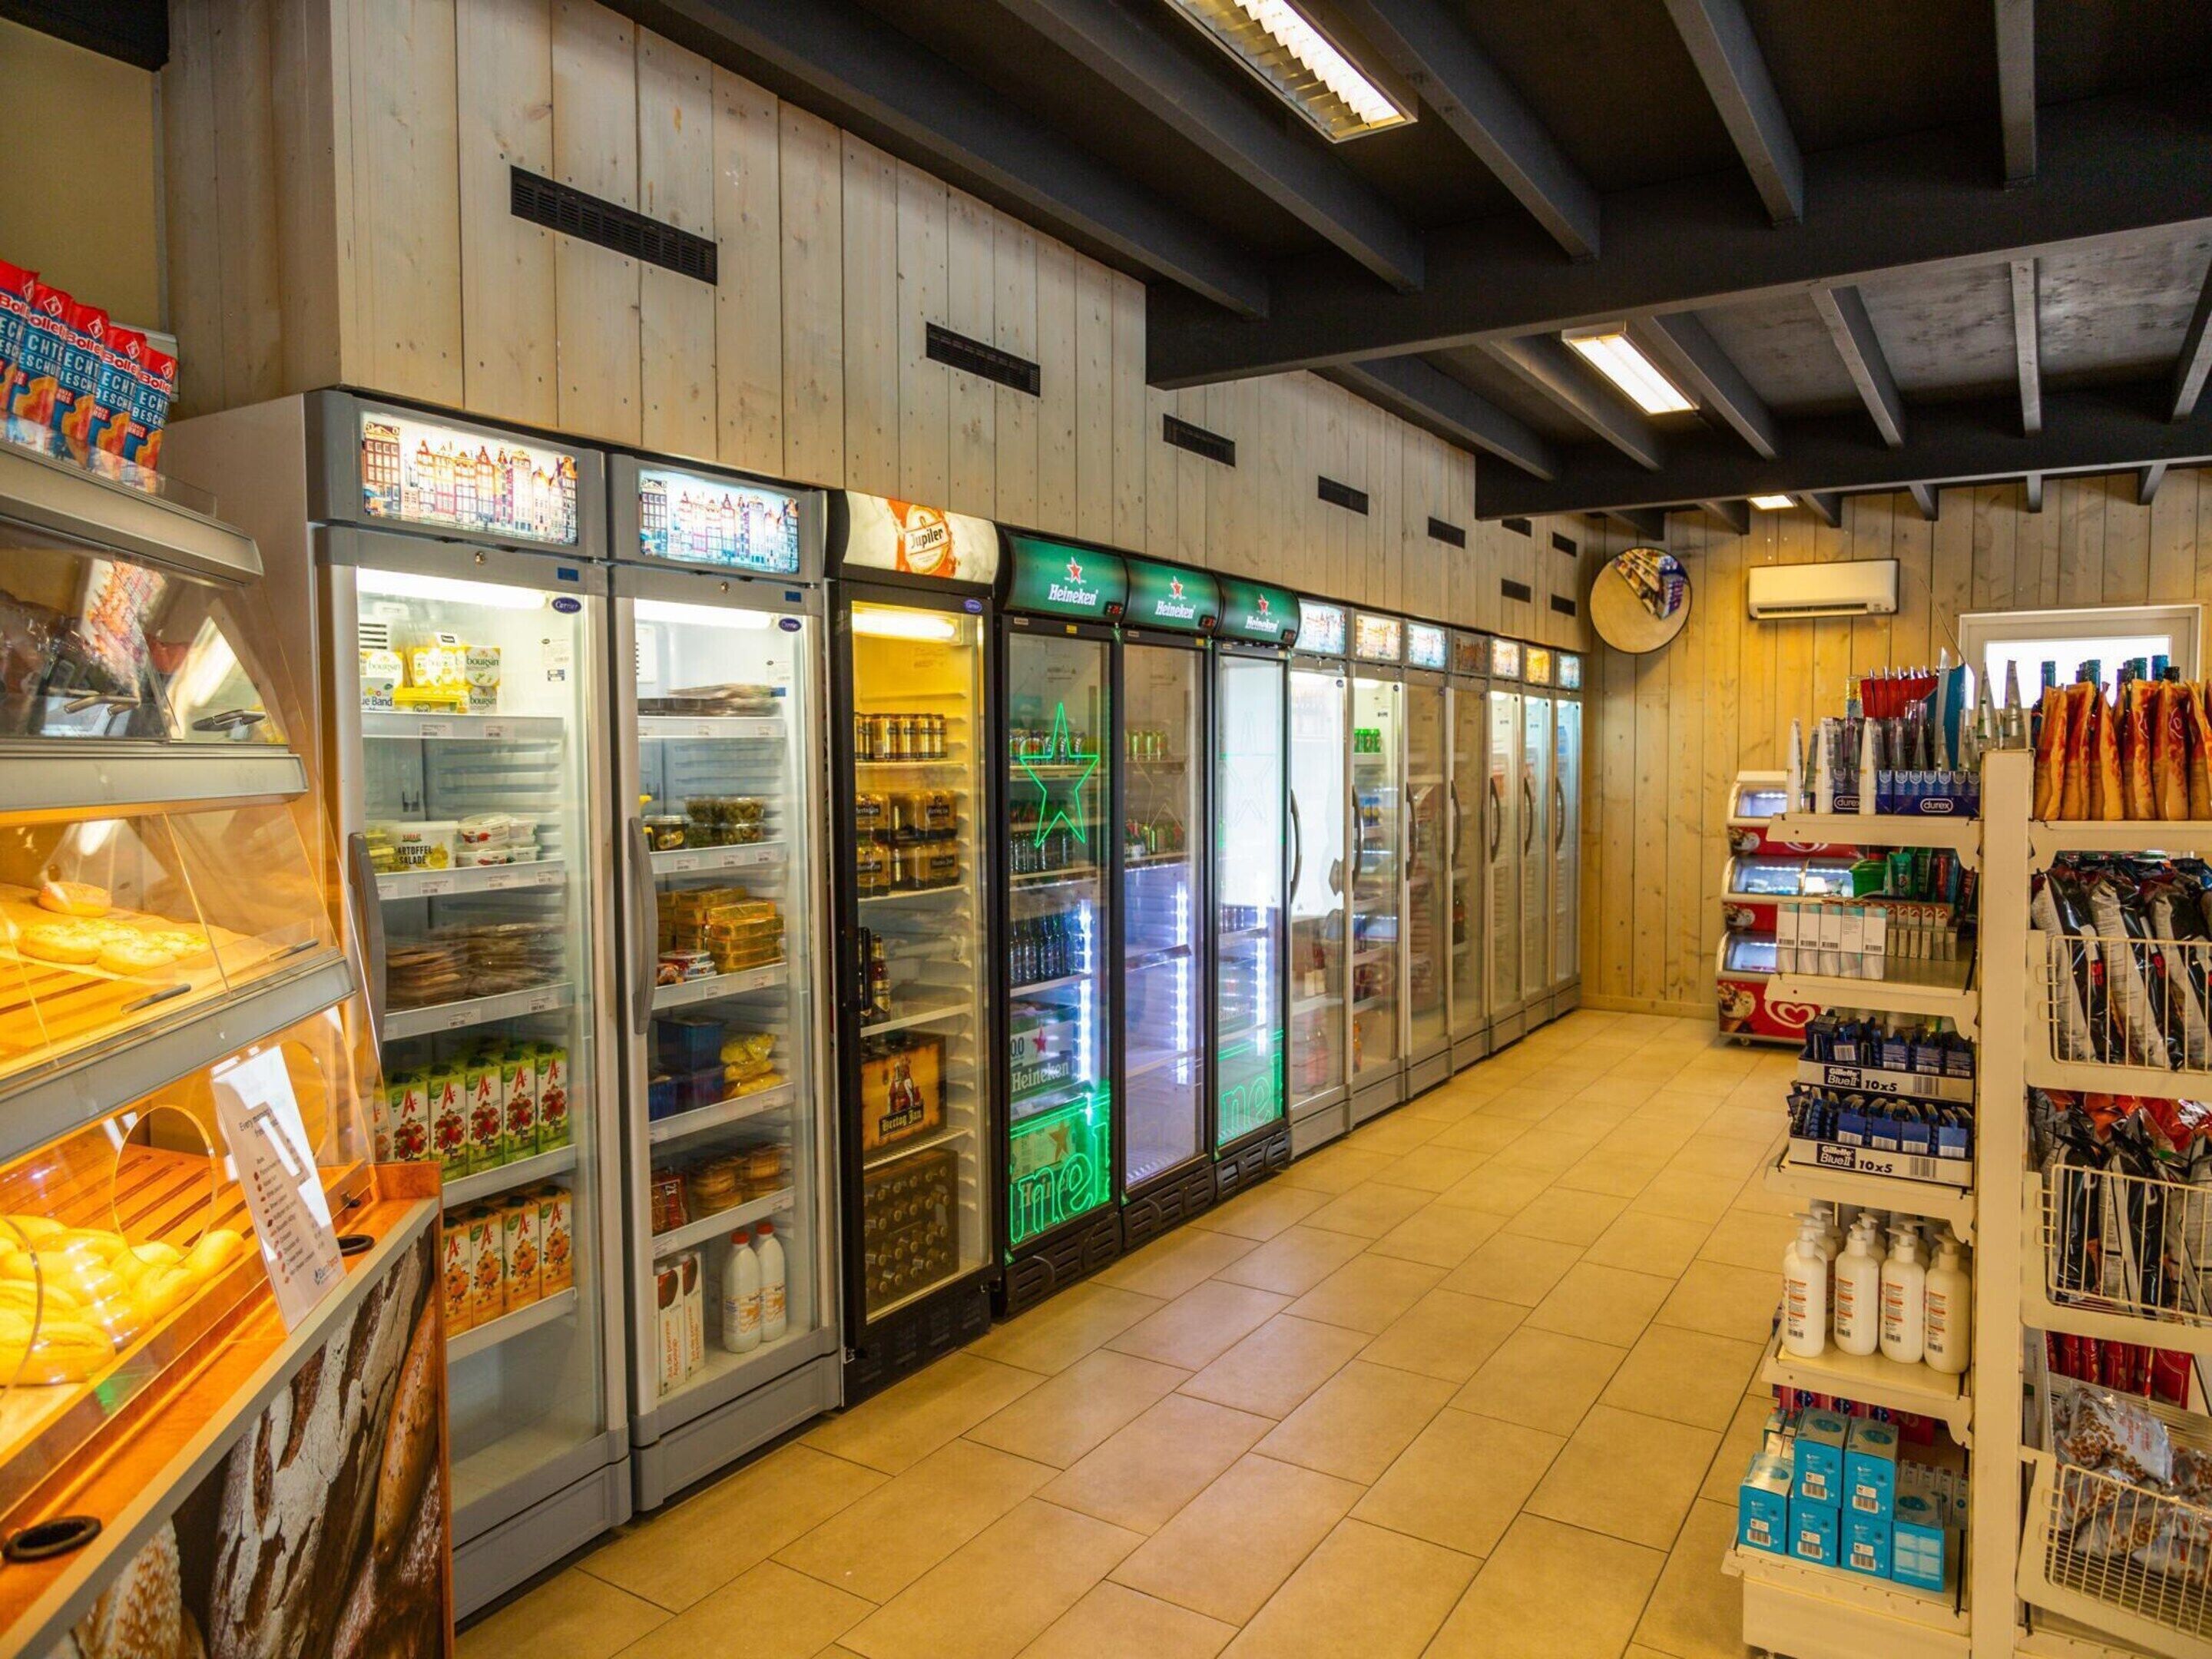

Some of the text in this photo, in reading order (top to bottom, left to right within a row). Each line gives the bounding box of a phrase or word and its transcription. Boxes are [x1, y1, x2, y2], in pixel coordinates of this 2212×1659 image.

[911, 527, 944, 549] Jupiler
[1048, 583, 1098, 606] Heineken
[1154, 599, 1195, 619] Heineken
[1244, 615, 1279, 634] Heineken
[466, 655, 499, 667] boursin
[470, 694, 496, 707] boursin
[1923, 800, 1949, 810] durex
[1012, 1061, 1069, 1092] Heineken
[1829, 1068, 1857, 1078] Gillette
[1865, 1079, 1898, 1091] 10x5
[1859, 1160, 1893, 1173] 10x5
